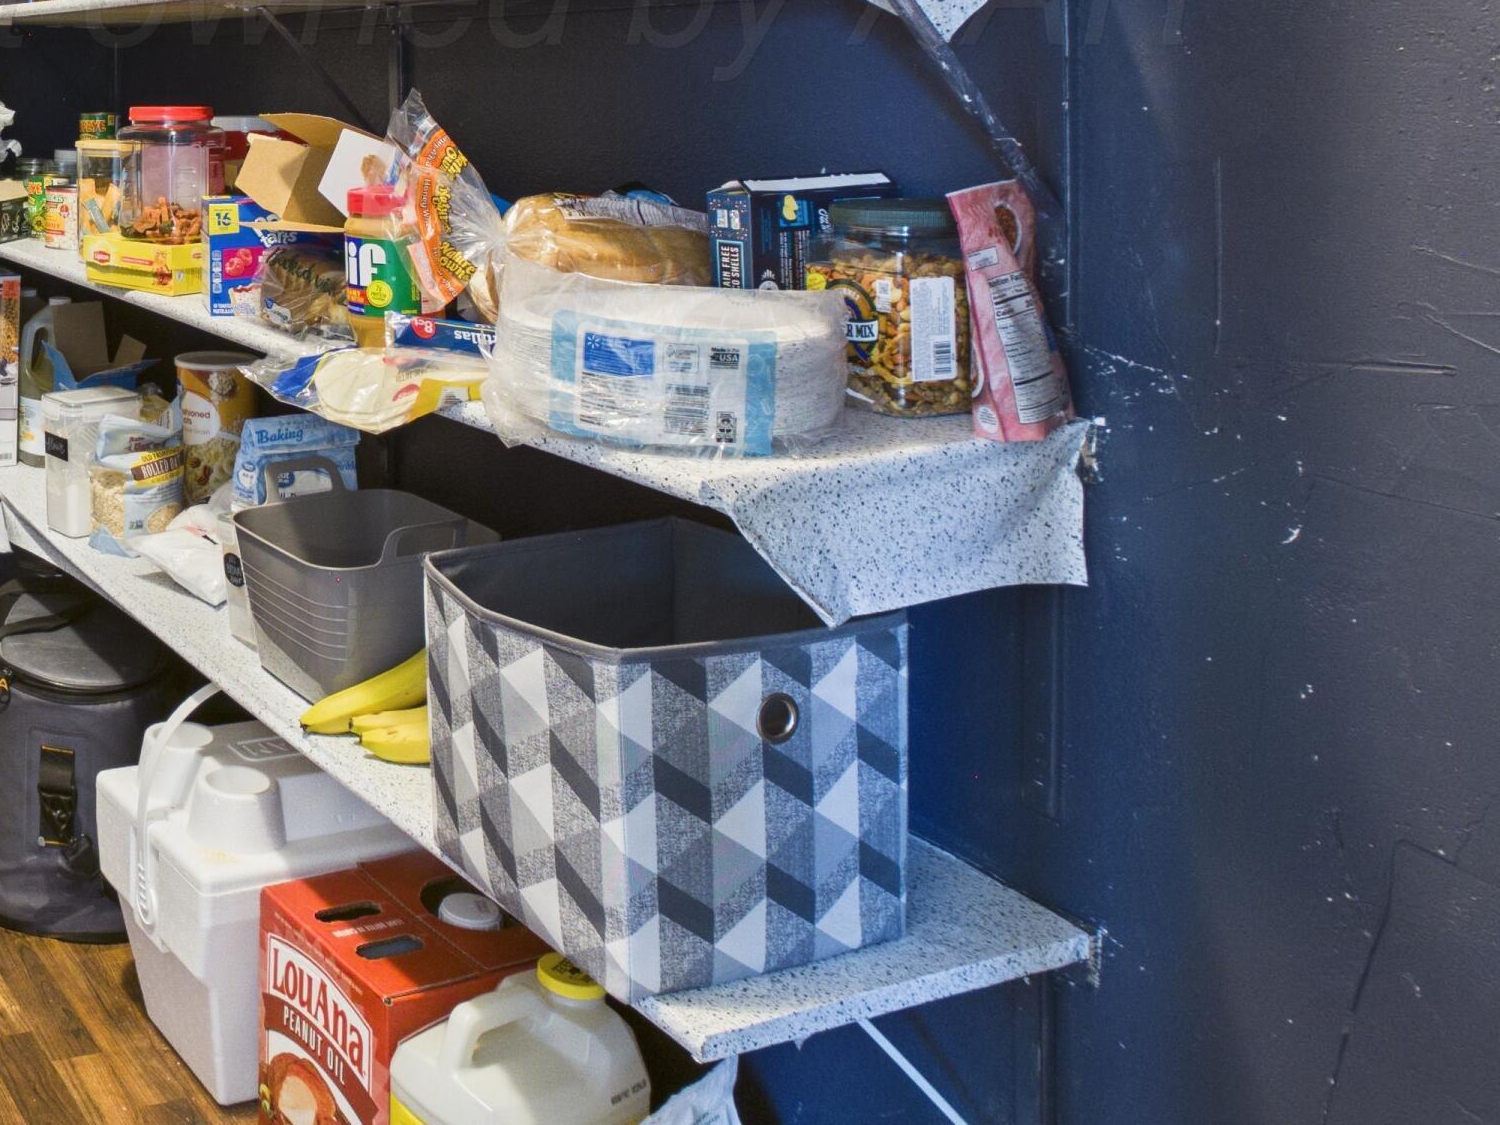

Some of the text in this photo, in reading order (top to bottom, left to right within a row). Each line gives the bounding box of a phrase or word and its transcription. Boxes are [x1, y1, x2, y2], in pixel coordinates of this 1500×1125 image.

[215, 212, 232, 225] 16
[855, 323, 875, 338] MIX
[719, 354, 739, 362] USA
[256, 428, 304, 445] Baking
[141, 459, 169, 478] ROLLED
[272, 947, 365, 1073] LouAna
[283, 1005, 345, 1086] PEANUT OIL
